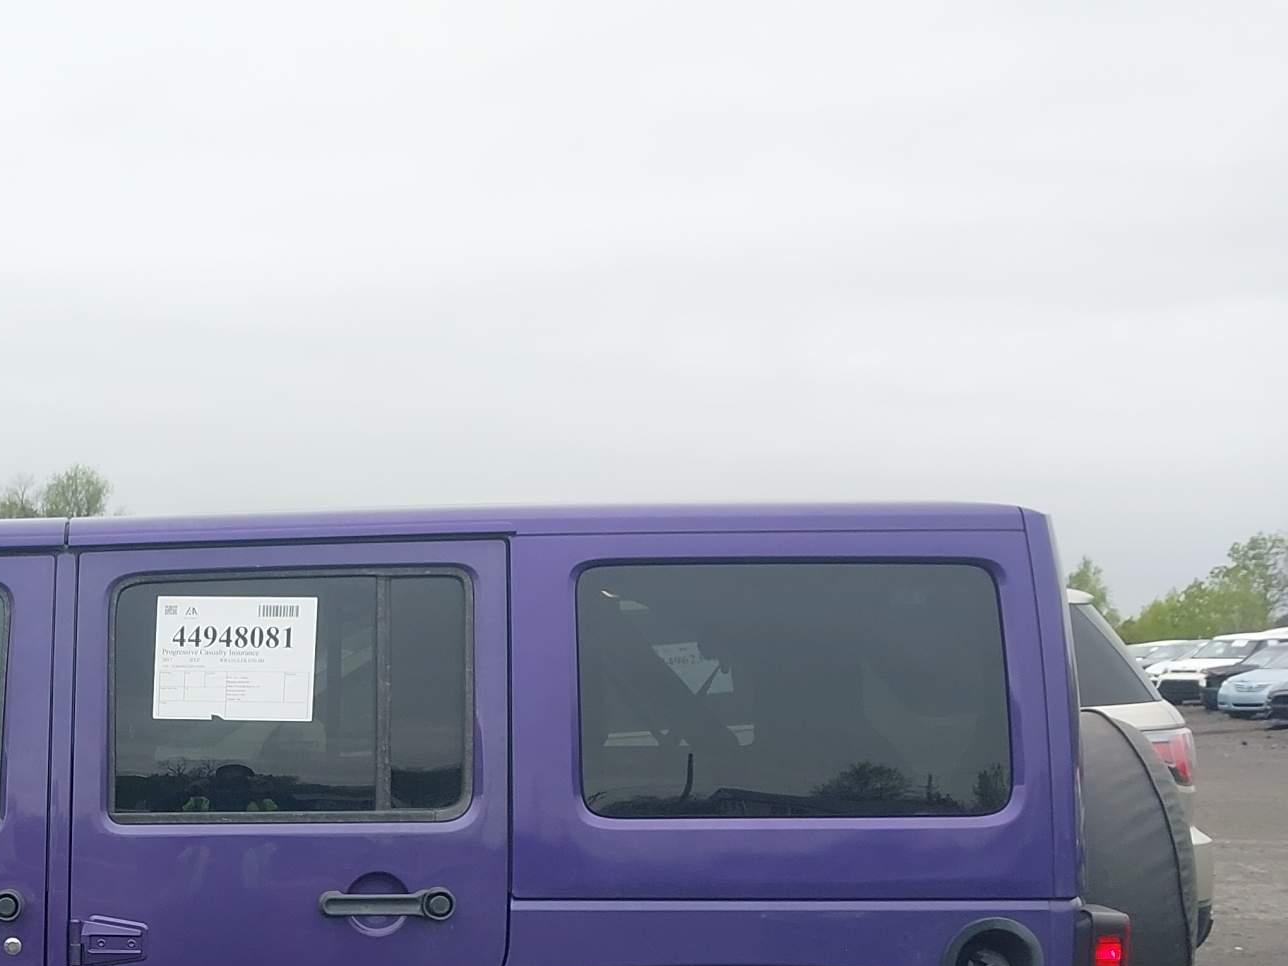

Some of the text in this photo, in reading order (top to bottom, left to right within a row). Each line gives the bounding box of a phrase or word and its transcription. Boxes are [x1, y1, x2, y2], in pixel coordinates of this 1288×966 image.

[172, 625, 293, 649] 44948081
[162, 648, 259, 657] Progressive Casualty Insurance
